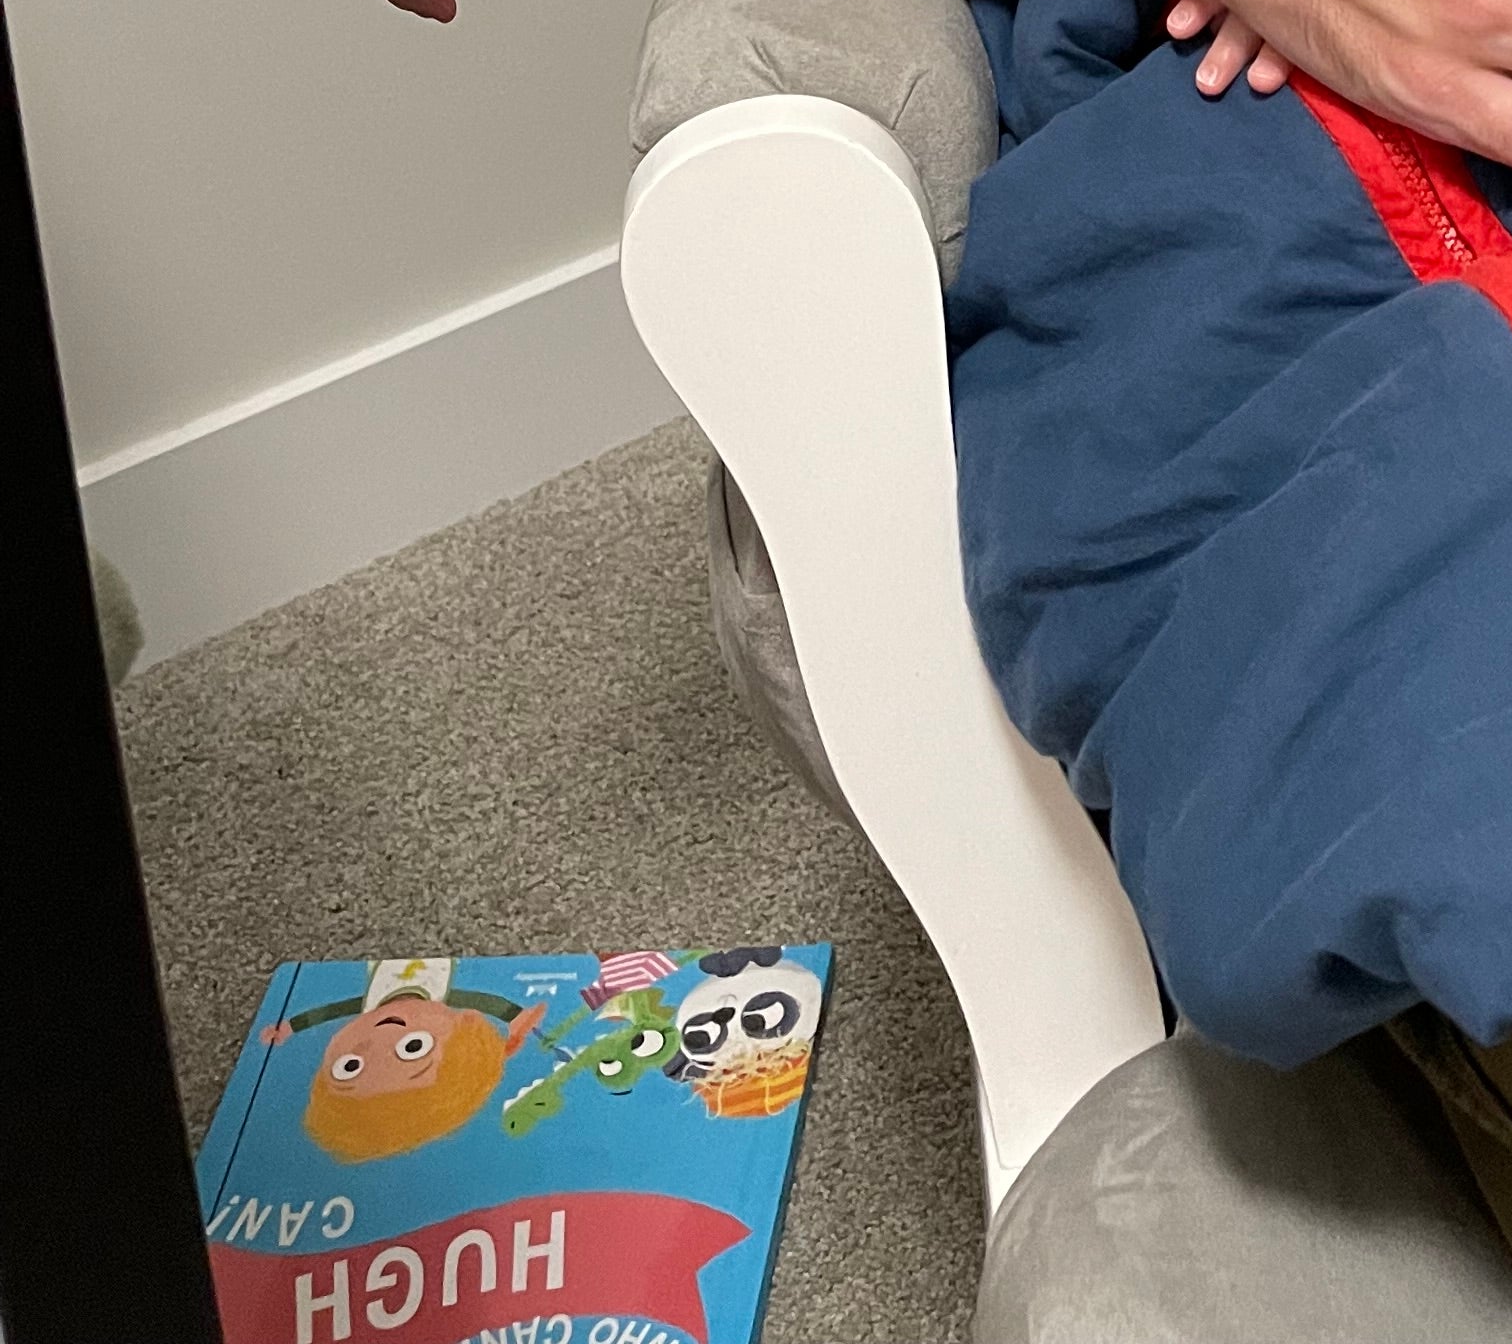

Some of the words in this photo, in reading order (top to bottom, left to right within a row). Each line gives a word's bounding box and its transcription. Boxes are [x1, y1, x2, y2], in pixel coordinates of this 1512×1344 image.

[206, 1195, 354, 1247] CAN!
[296, 1210, 565, 1344] HUGH
[459, 1313, 572, 1344] CAN
